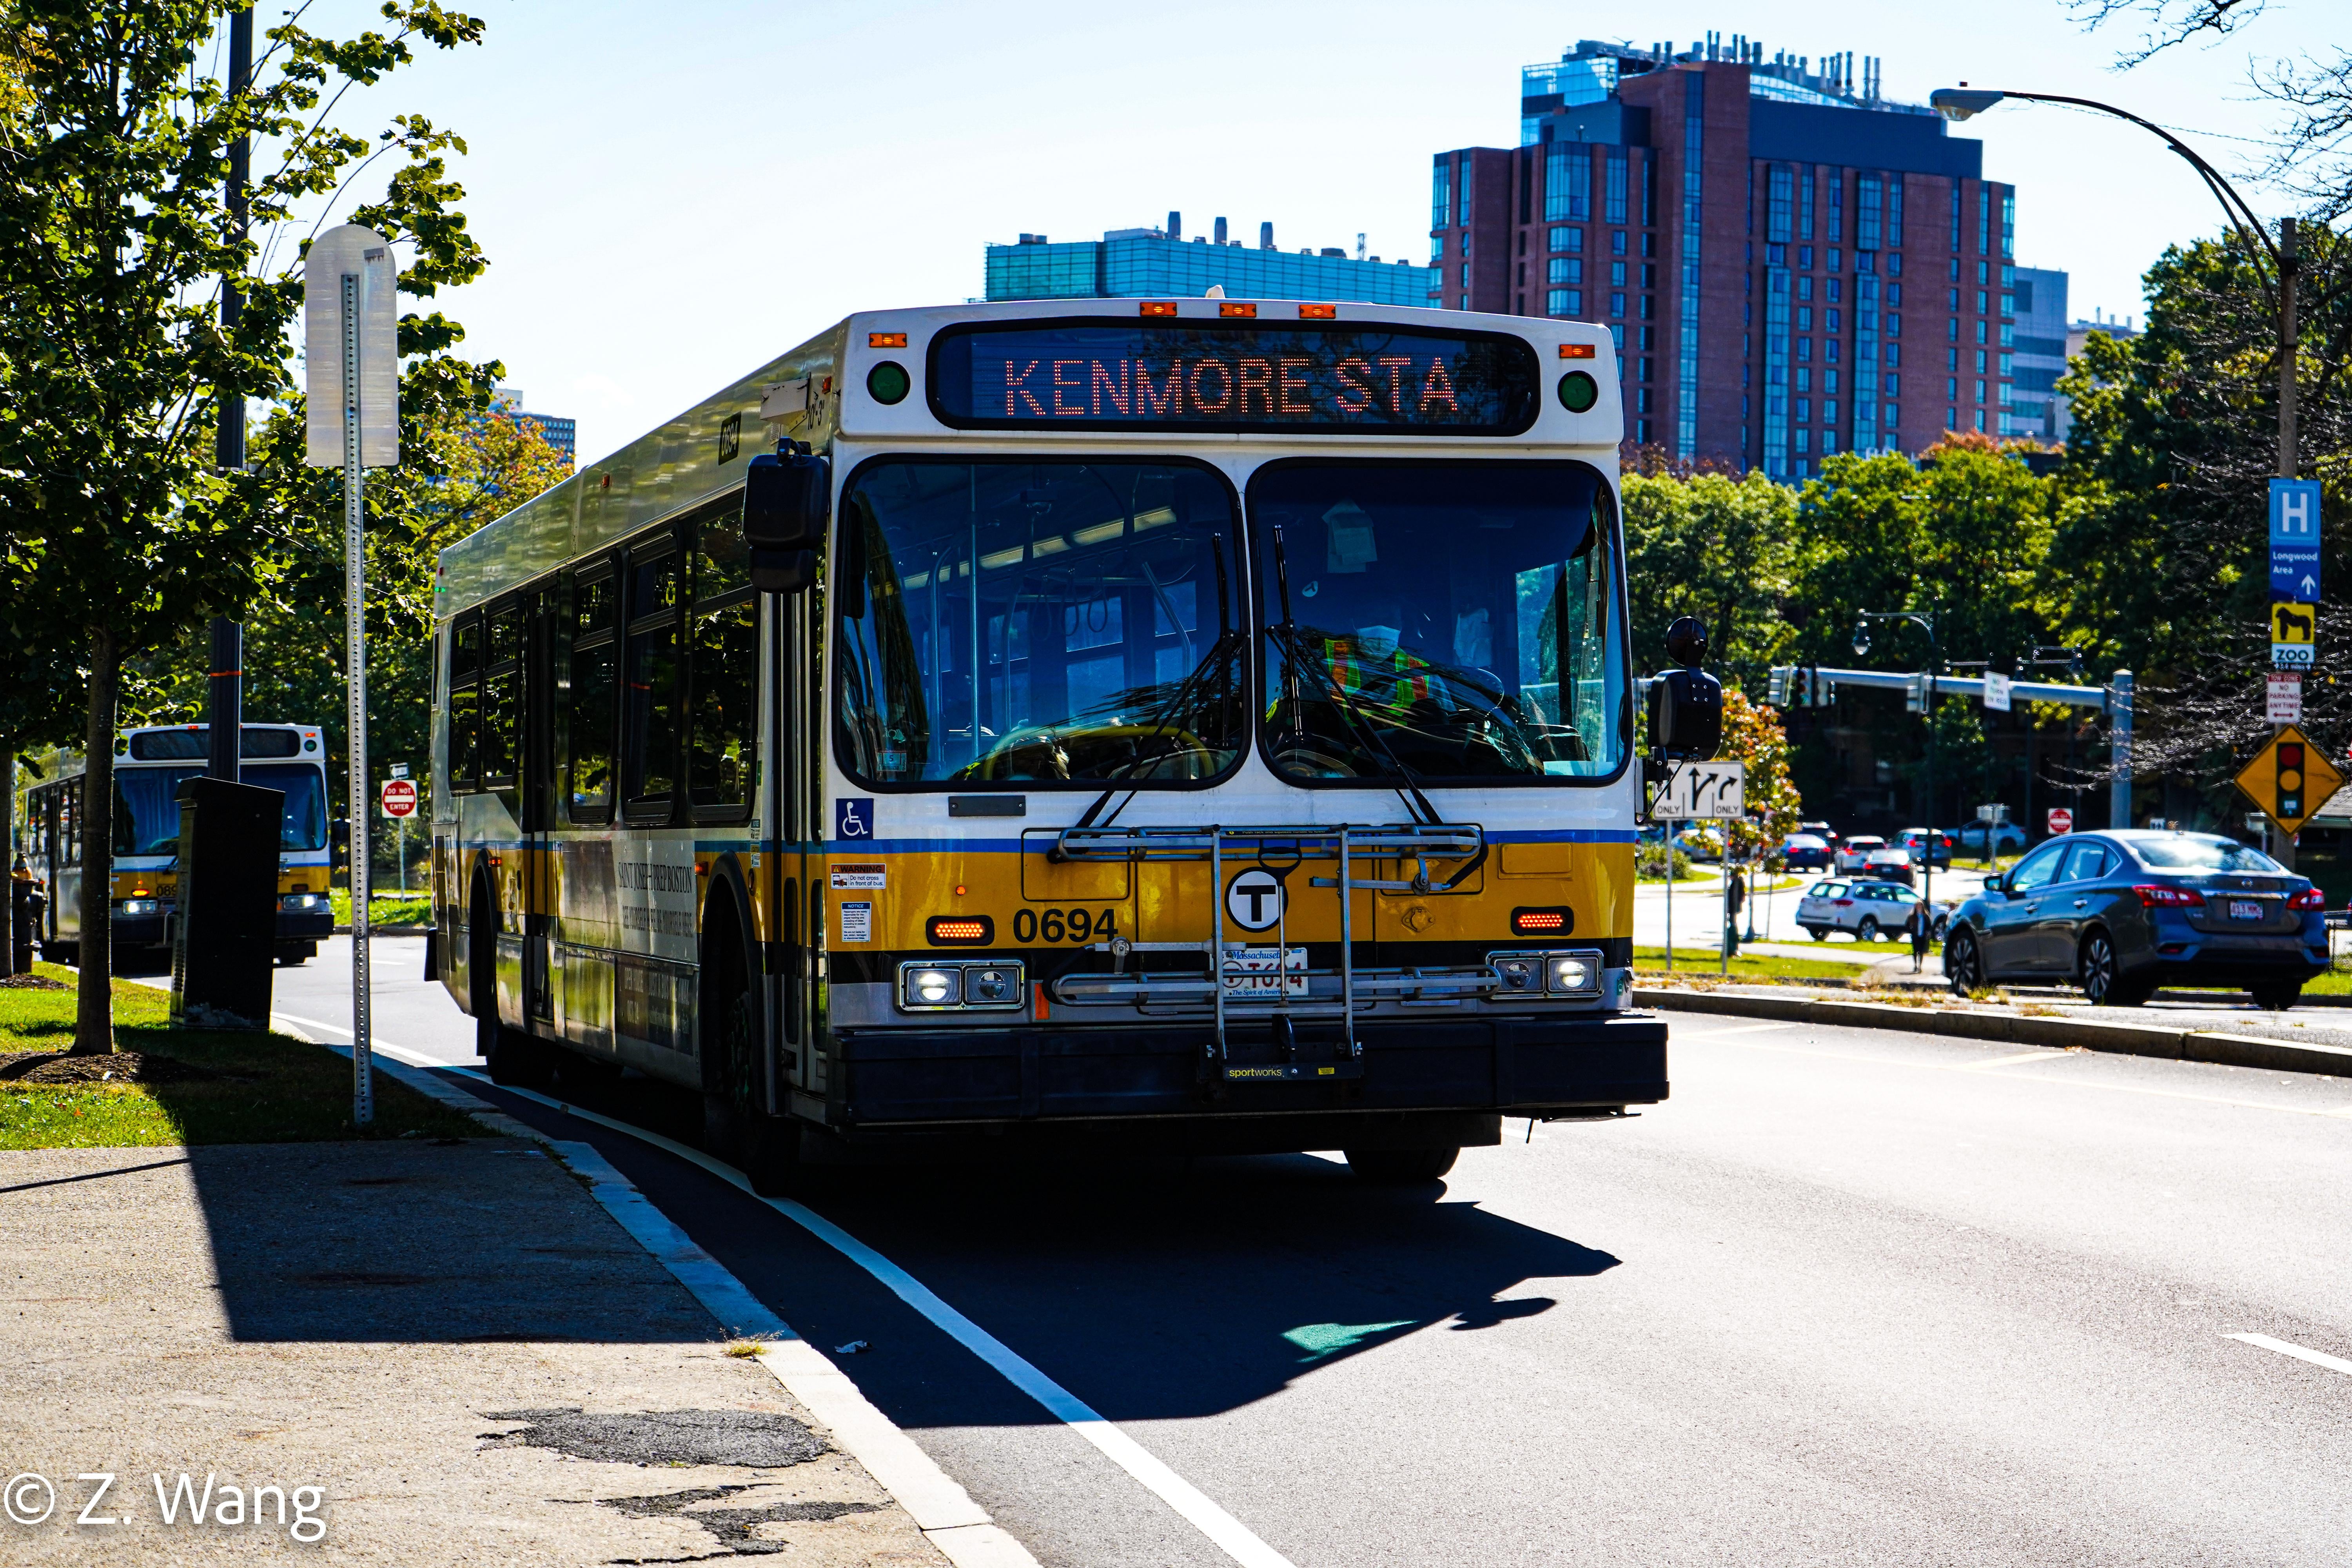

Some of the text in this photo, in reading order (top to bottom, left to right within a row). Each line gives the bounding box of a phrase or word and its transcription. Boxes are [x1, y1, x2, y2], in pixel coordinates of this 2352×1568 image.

[1005, 358, 1458, 415] KENMORE STA
[721, 421, 738, 456] 0694
[2282, 492, 2308, 533] H
[2273, 551, 2318, 563] Longwood
[2273, 564, 2293, 575] Area
[2276, 649, 2309, 661] ZOO
[1657, 805, 1681, 814] ONLY
[1715, 805, 1739, 814] ONLY
[619, 862, 633, 888] SAINT
[653, 864, 667, 892] PREP
[668, 865, 692, 894] BOSTON
[1236, 885, 1276, 922] T
[1013, 908, 1118, 943] 0694
[1232, 951, 1281, 960] Massachuset
[1229, 1068, 1282, 1078] sportworks
